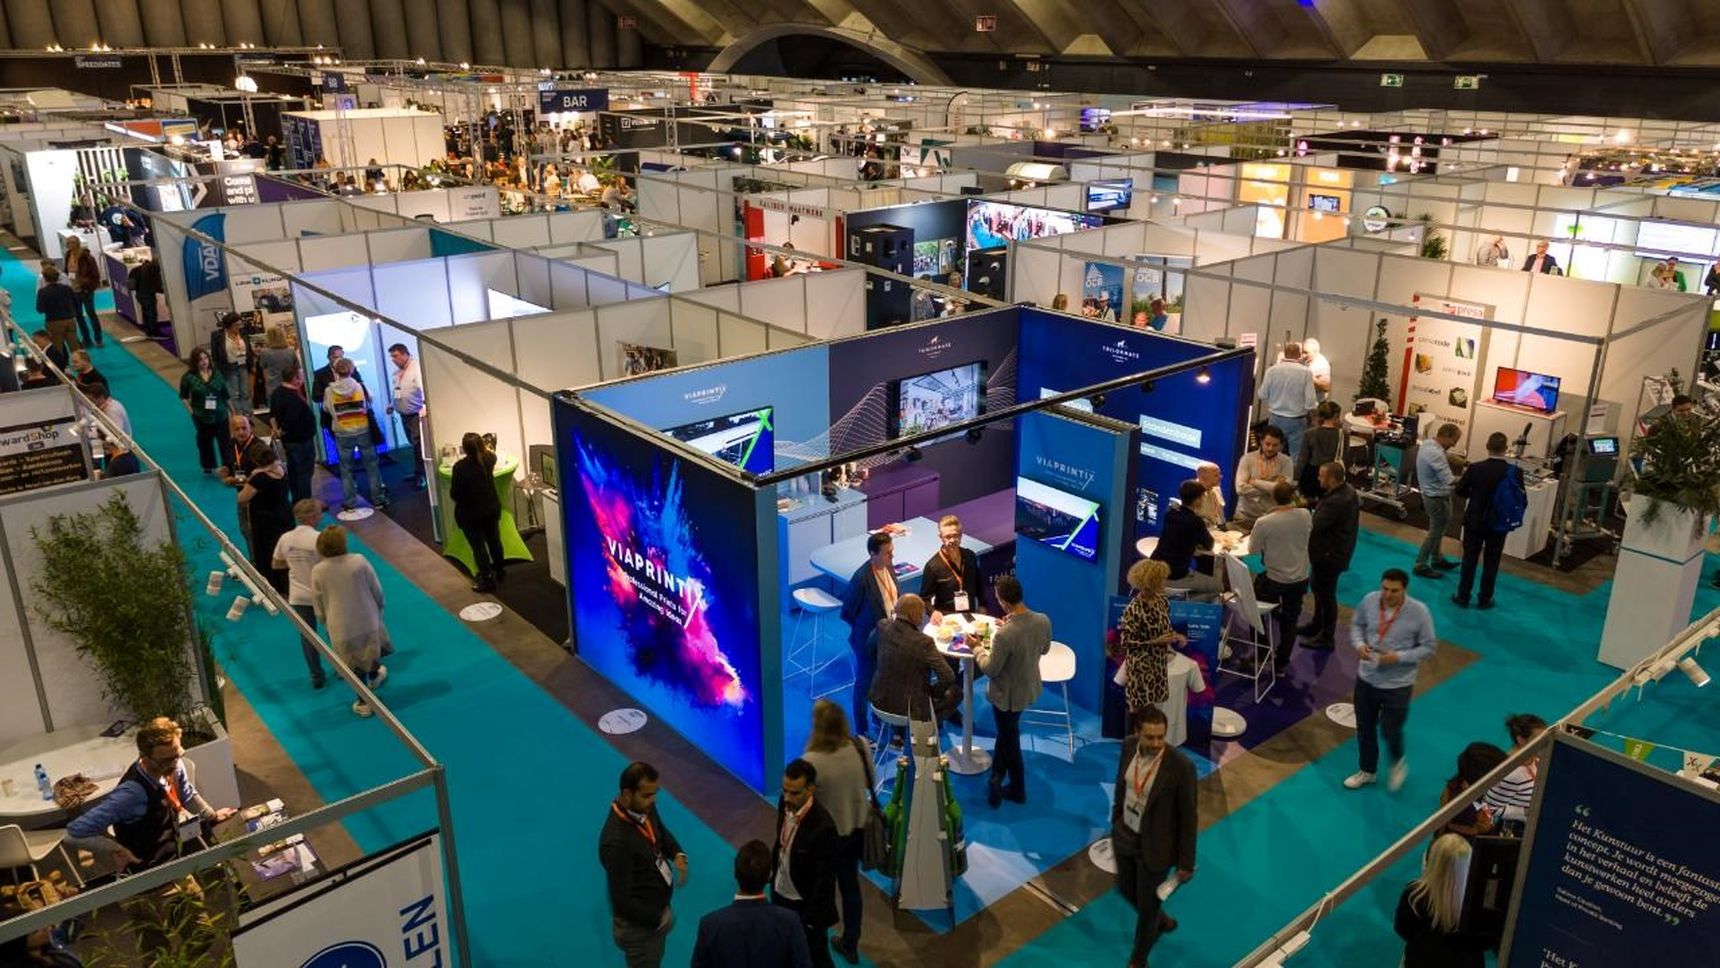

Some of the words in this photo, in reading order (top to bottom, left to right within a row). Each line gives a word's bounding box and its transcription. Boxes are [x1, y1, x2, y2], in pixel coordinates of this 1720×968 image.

[563, 96, 587, 107] BAR
[227, 186, 244, 196] and
[228, 196, 247, 205] with
[1085, 277, 1103, 288] OCB
[1136, 273, 1160, 284] OCB
[1036, 456, 1096, 490] VIAPRINTIX
[606, 536, 709, 628] VIAPRINTIX
[1568, 832, 1610, 855] concept.
[1611, 850, 1625, 862] Je
[1626, 857, 1659, 877] wordt
[1571, 819, 1592, 835] Het
[1592, 829, 1645, 857] Kunstuur
[1646, 851, 1655, 863] is
[1657, 858, 1677, 871] een
[1561, 864, 1583, 880] dan
[1582, 874, 1595, 885] je
[1594, 881, 1635, 904] gewoon
[1563, 852, 1630, 889] kunstwerken
[1631, 881, 1655, 901] heel
[1655, 895, 1697, 919] anders
[1566, 841, 1577, 853] in
[1579, 847, 1596, 861] het
[1597, 857, 1639, 880] verhaal
[1639, 875, 1653, 888] en
[1655, 880, 1692, 903] beleeft
[1692, 896, 1709, 911] de
